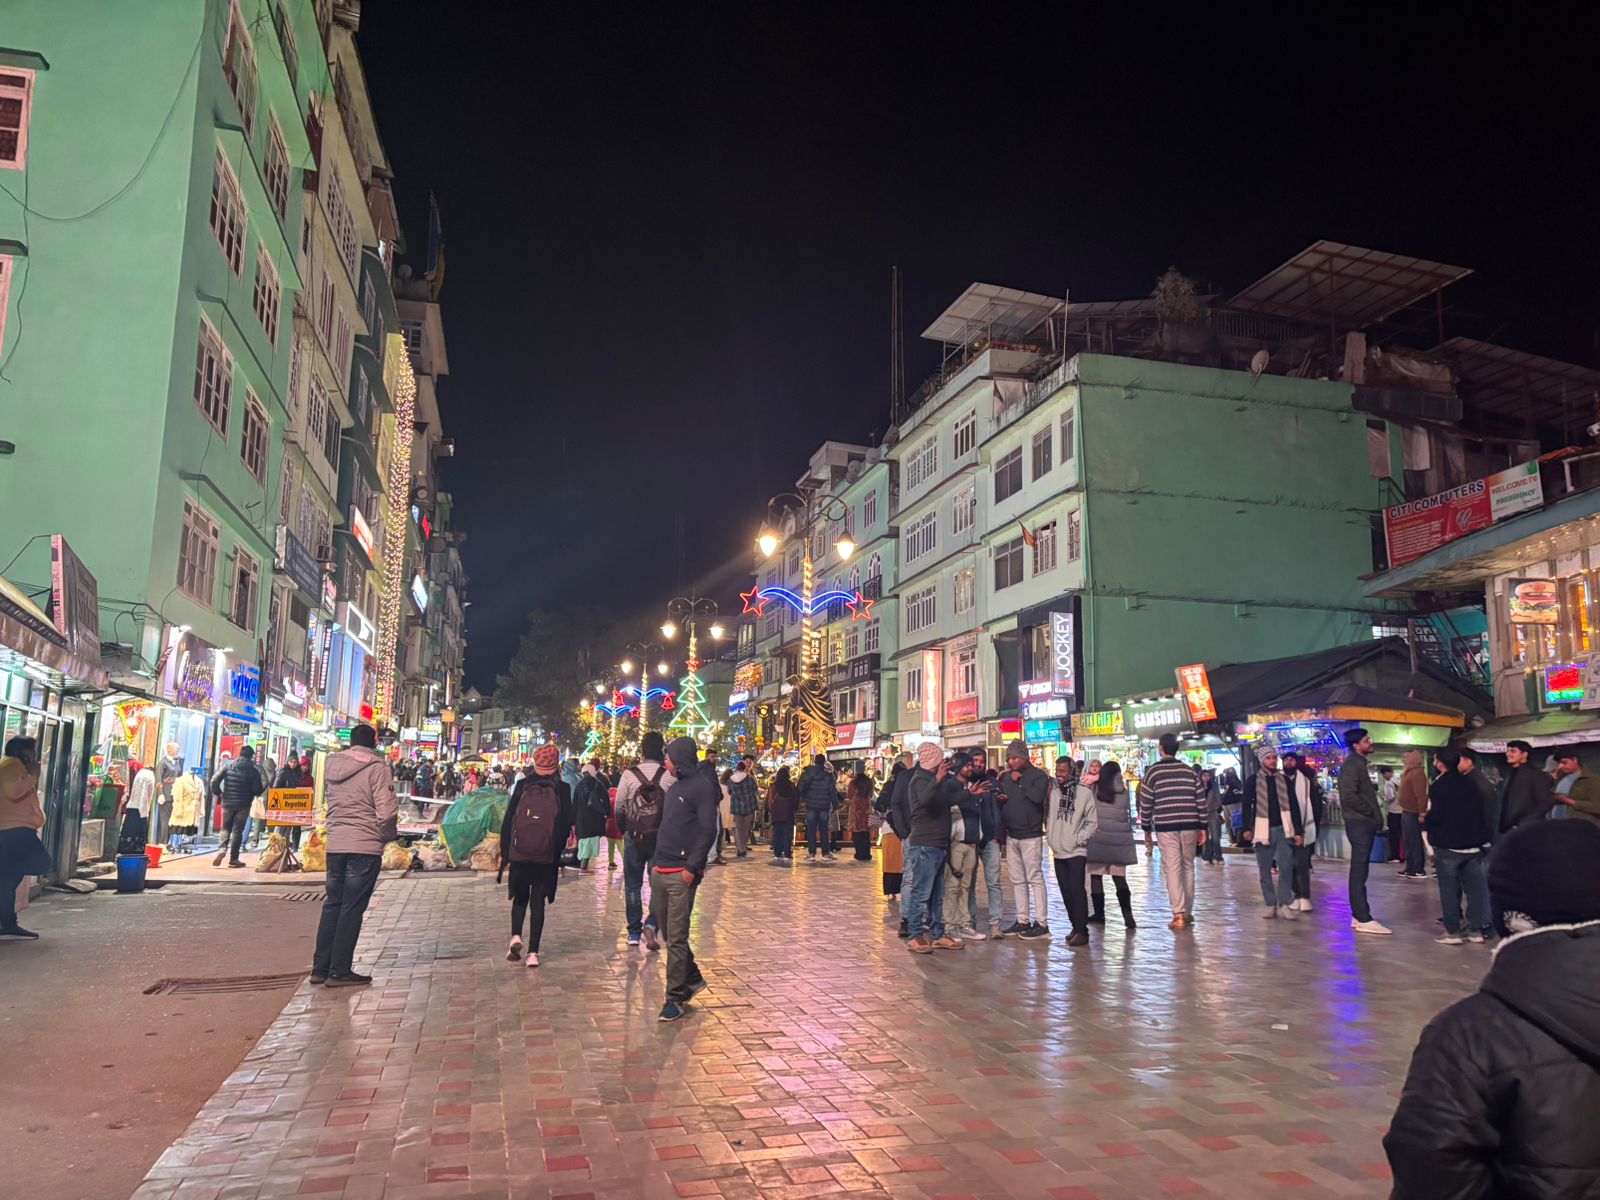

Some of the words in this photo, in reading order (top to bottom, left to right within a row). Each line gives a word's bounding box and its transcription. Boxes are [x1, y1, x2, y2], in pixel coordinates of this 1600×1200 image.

[1491, 479, 1525, 495] WELCOME
[1390, 502, 1410, 519] CITI
[1414, 480, 1485, 512] COMPUTERS
[1056, 614, 1071, 678] JOCKEY
[1097, 711, 1114, 728] GIFT
[1134, 708, 1181, 728] SAMSUNG
